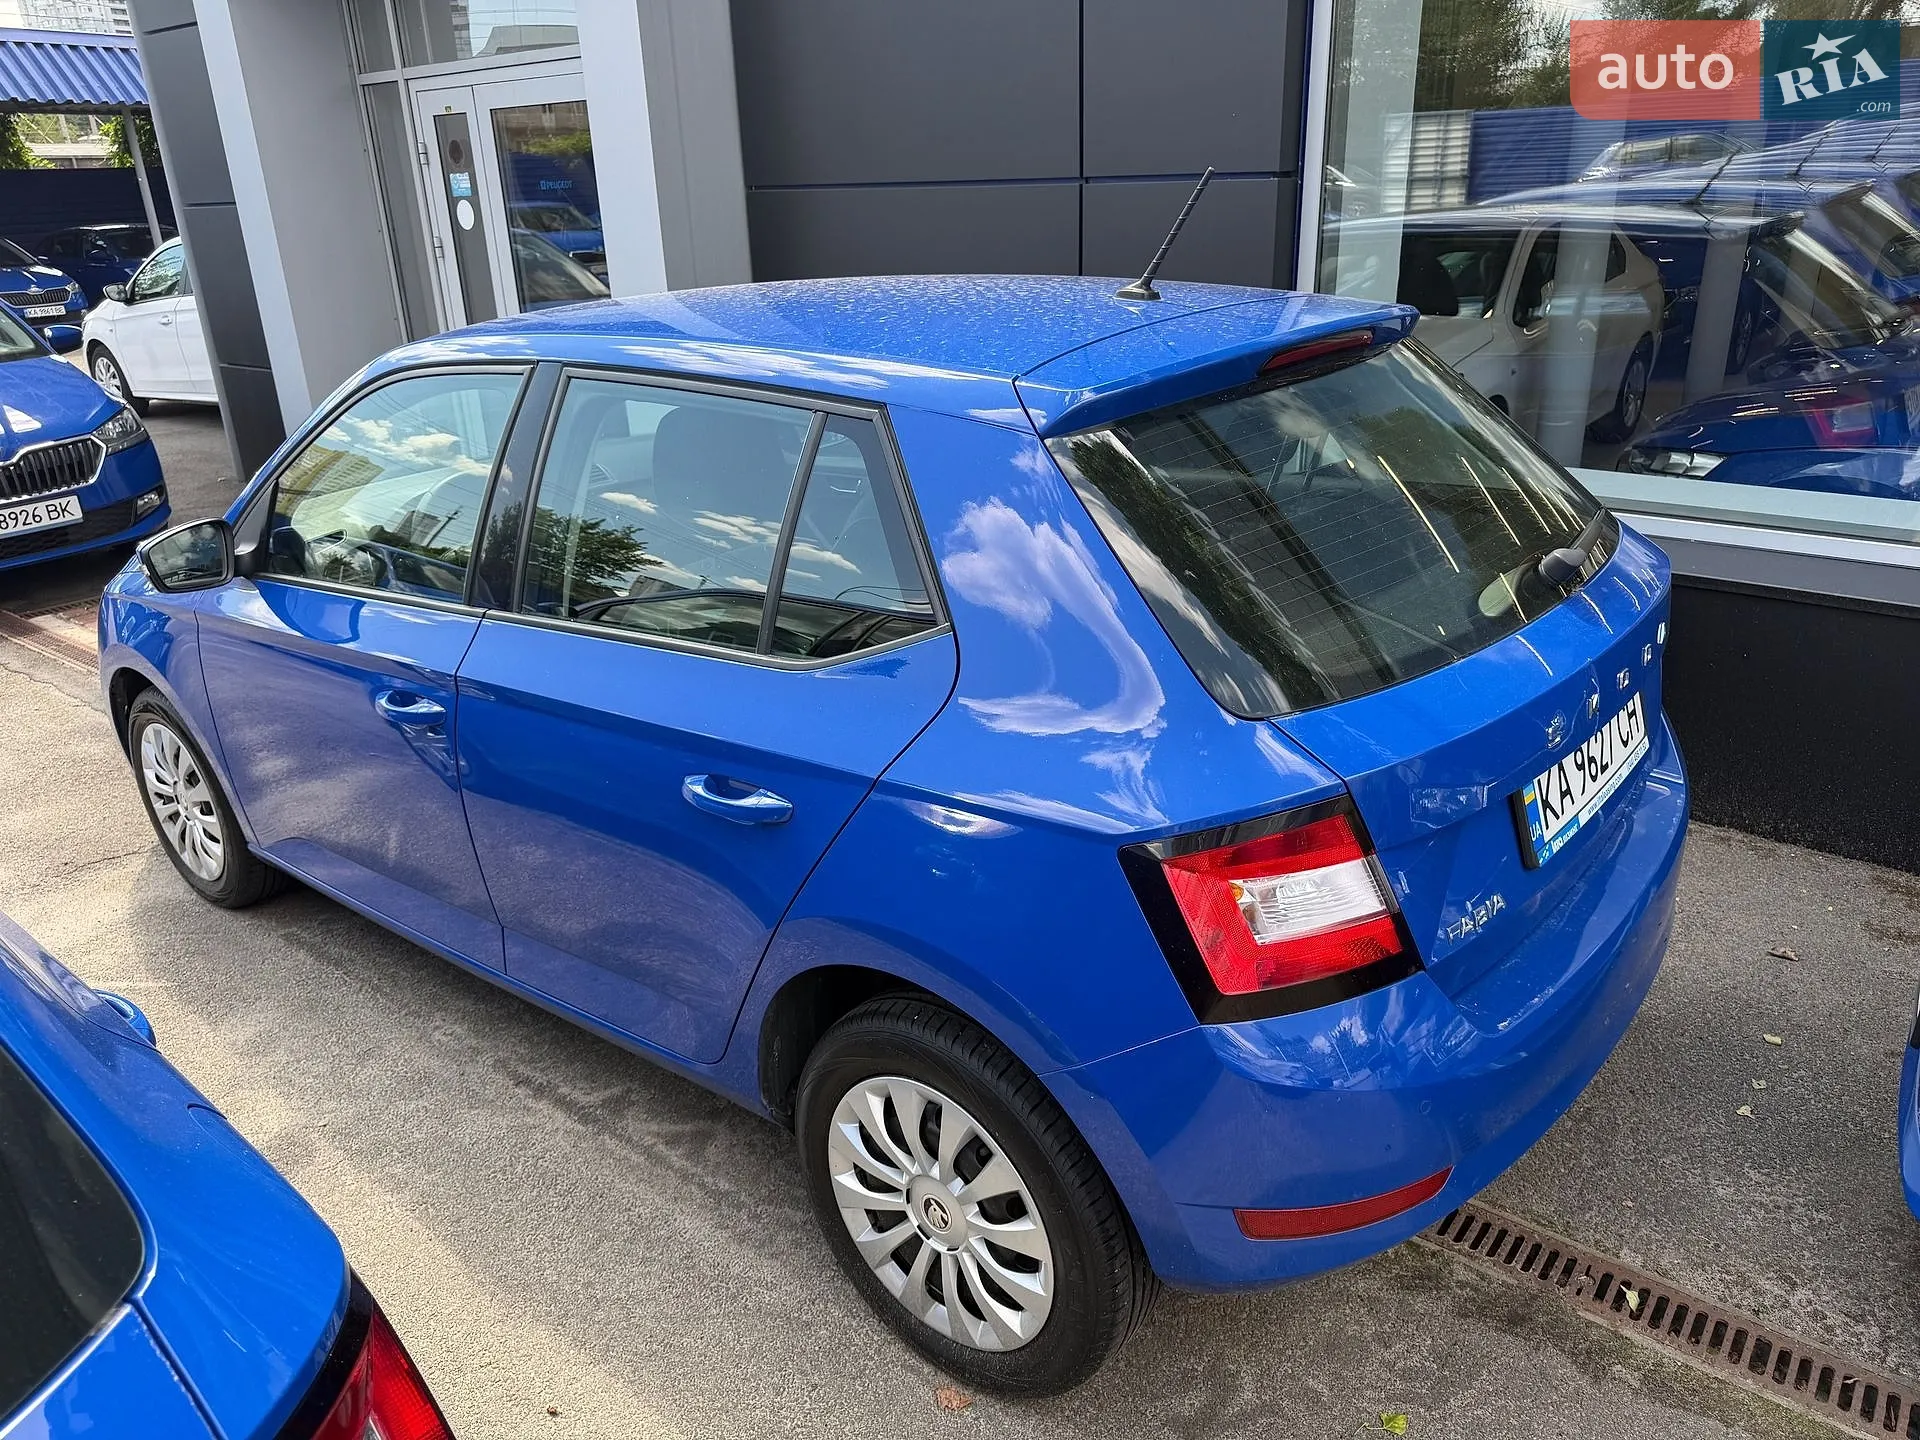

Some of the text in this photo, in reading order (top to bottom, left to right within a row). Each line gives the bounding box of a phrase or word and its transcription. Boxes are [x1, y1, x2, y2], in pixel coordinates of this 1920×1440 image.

[0, 500, 75, 530] 8926 BK
[1536, 759, 1575, 830] KA
[1573, 720, 1613, 797] 9627
[1616, 697, 1641, 749] CH
[1529, 820, 1543, 842] UA
[1446, 893, 1505, 946] FABIA
